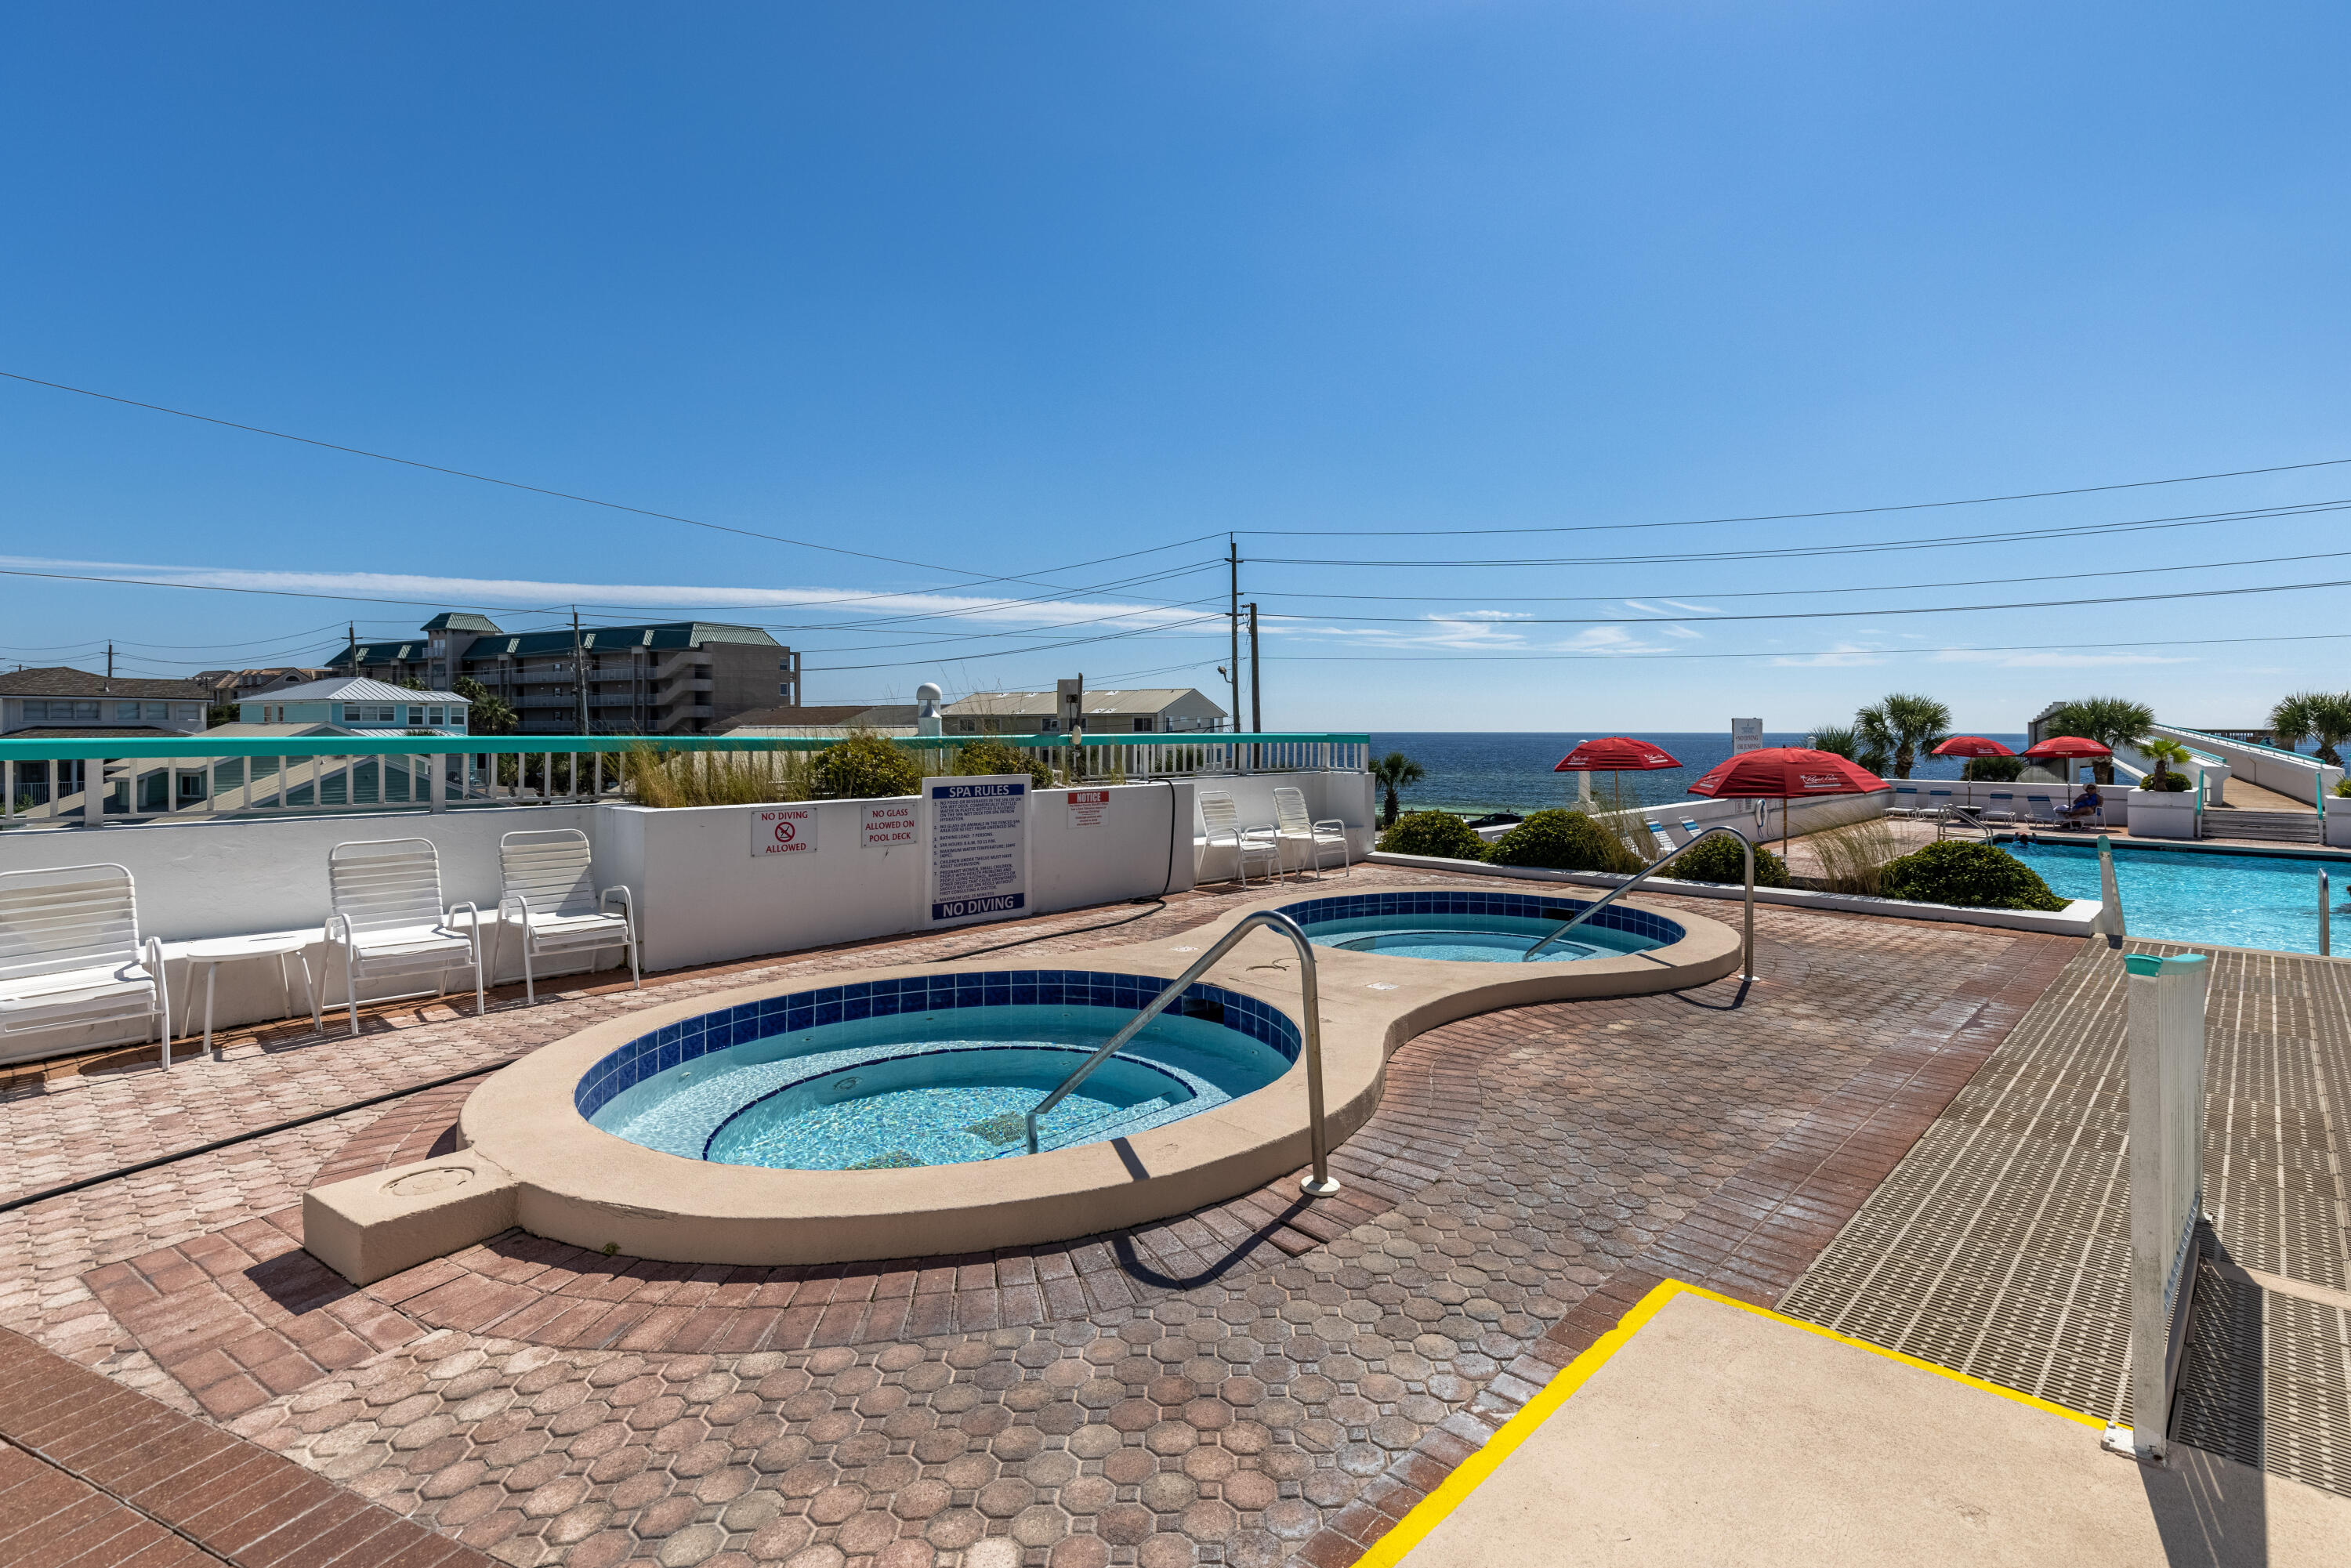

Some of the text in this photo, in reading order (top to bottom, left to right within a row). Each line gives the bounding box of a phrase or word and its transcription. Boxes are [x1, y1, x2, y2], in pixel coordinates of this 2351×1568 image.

[949, 785, 1009, 798] SPA RULES
[1077, 792, 1100, 802] NOTICE
[778, 811, 808, 820] DIVING
[865, 821, 900, 831] ALLOWED
[869, 834, 889, 842] POOL
[766, 843, 806, 853] ALLOWED
[944, 896, 1014, 917] NO DIVING
